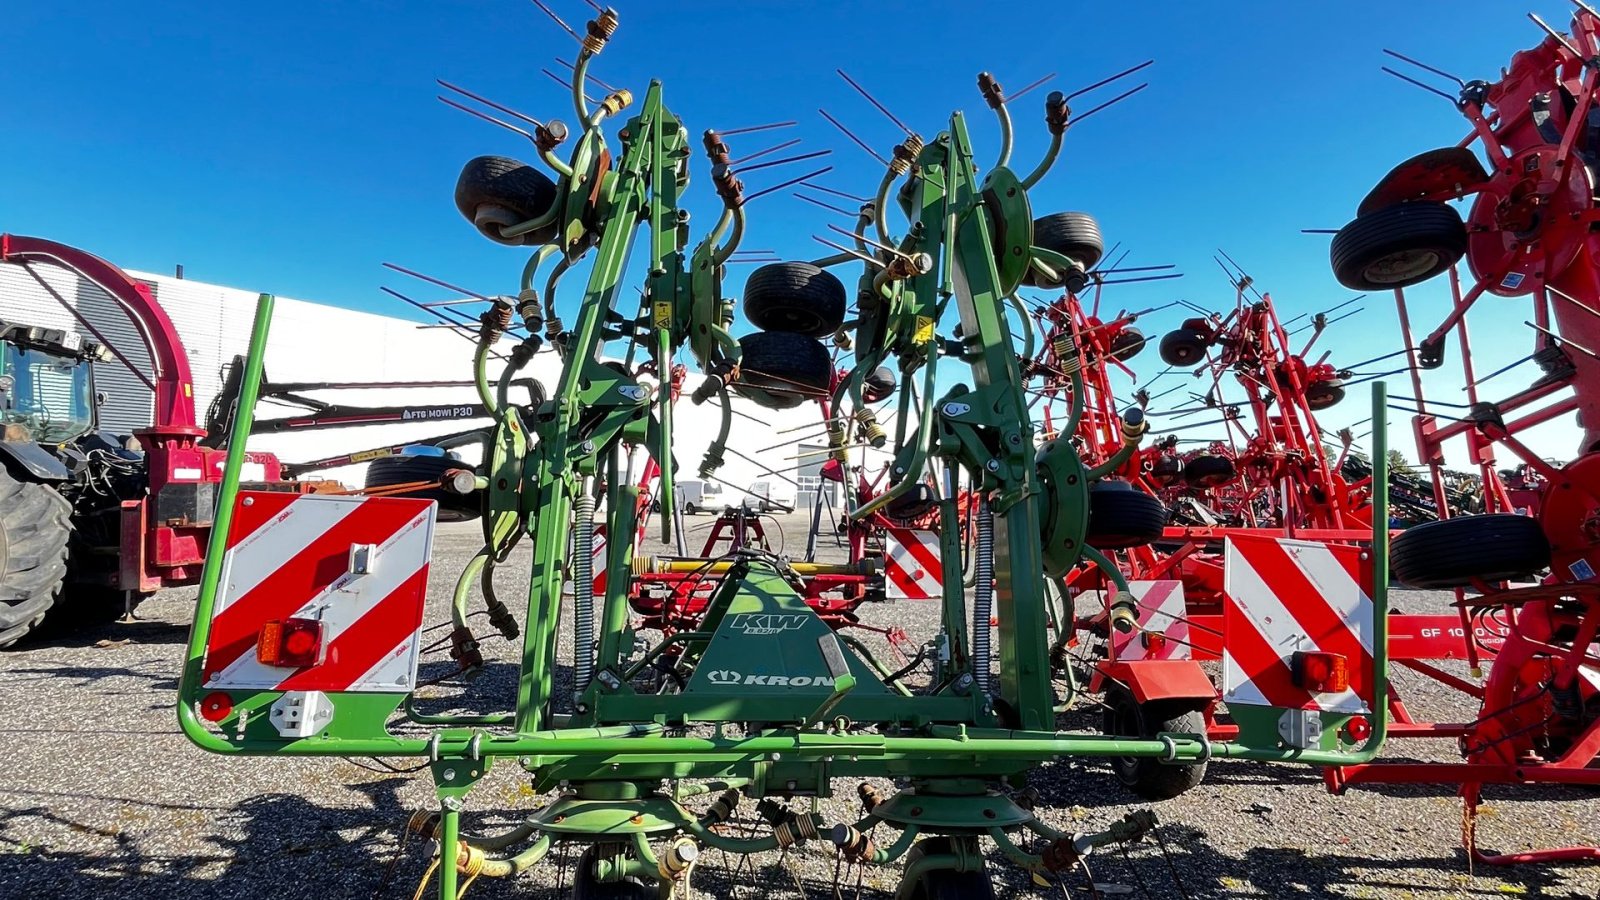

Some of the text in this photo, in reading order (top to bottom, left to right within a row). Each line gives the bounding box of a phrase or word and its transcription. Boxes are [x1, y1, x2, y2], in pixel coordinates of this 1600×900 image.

[411, 407, 473, 419] FTG MOWI P30
[730, 614, 809, 630] KW
[1421, 628, 1441, 637] GF
[744, 675, 835, 687] KRON
